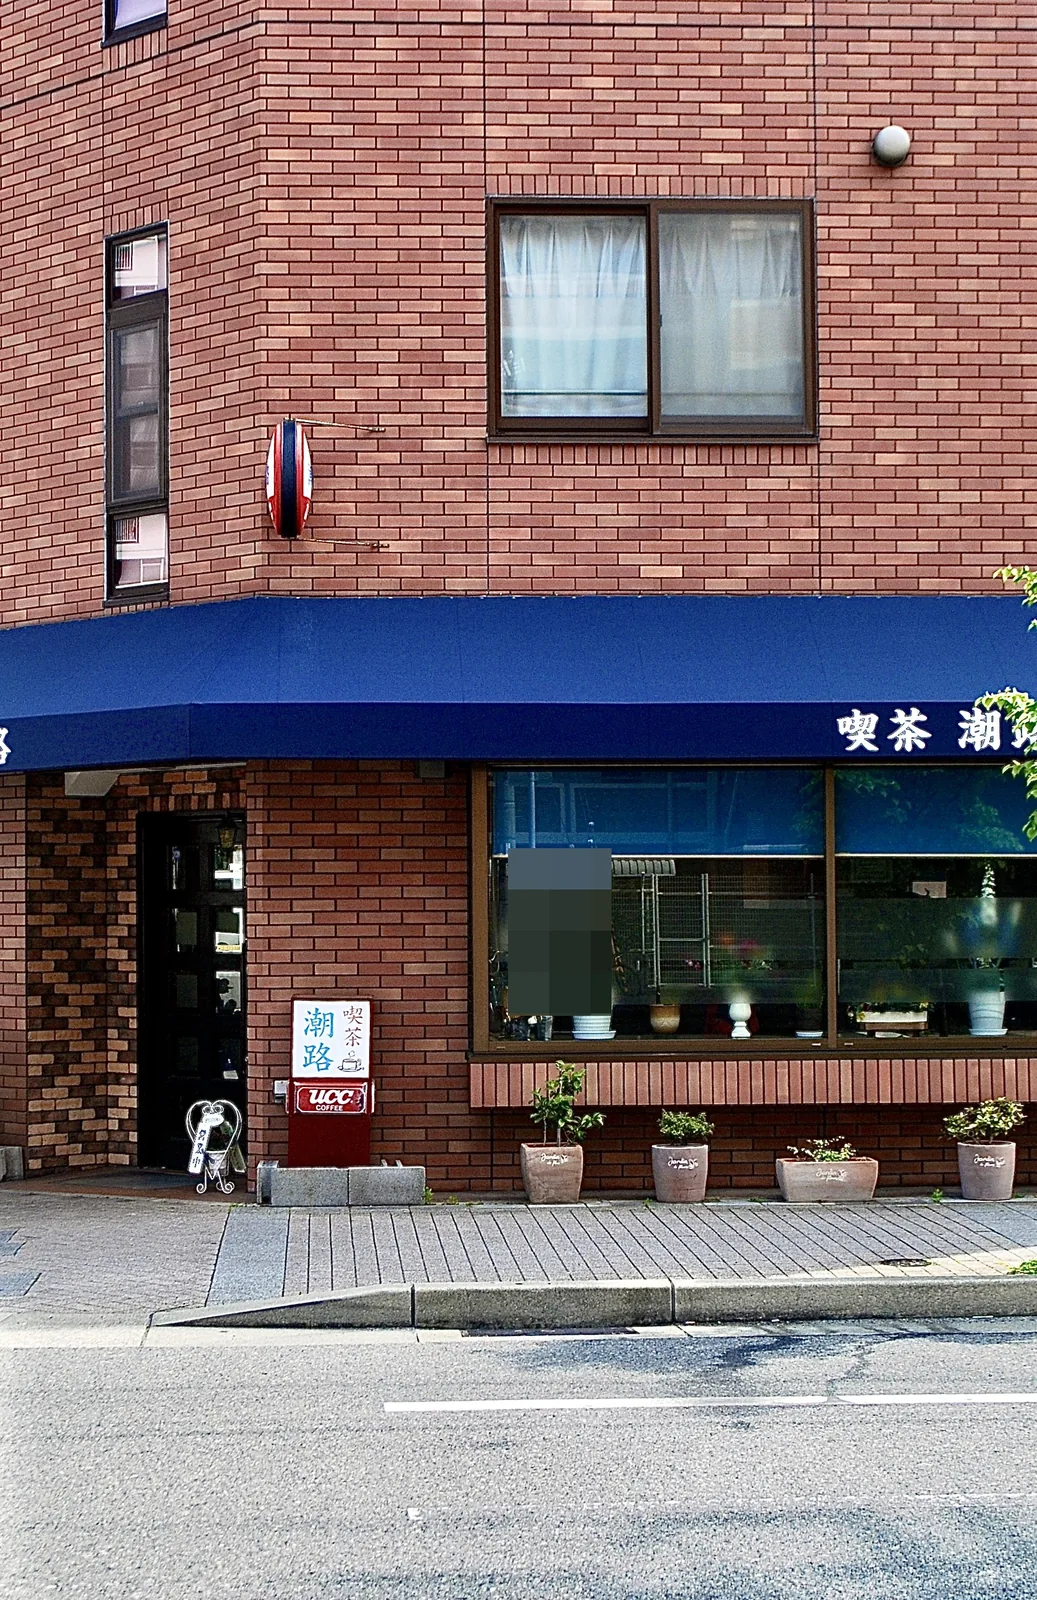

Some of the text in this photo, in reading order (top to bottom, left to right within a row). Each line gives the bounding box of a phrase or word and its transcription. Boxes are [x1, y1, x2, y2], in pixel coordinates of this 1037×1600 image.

[836, 707, 932, 753] 喫茶
[302, 1007, 335, 1073] 潮路
[343, 1005, 364, 1047] 喫茶
[309, 1089, 354, 1105] UCC
[315, 1104, 344, 1112] COFFEE
